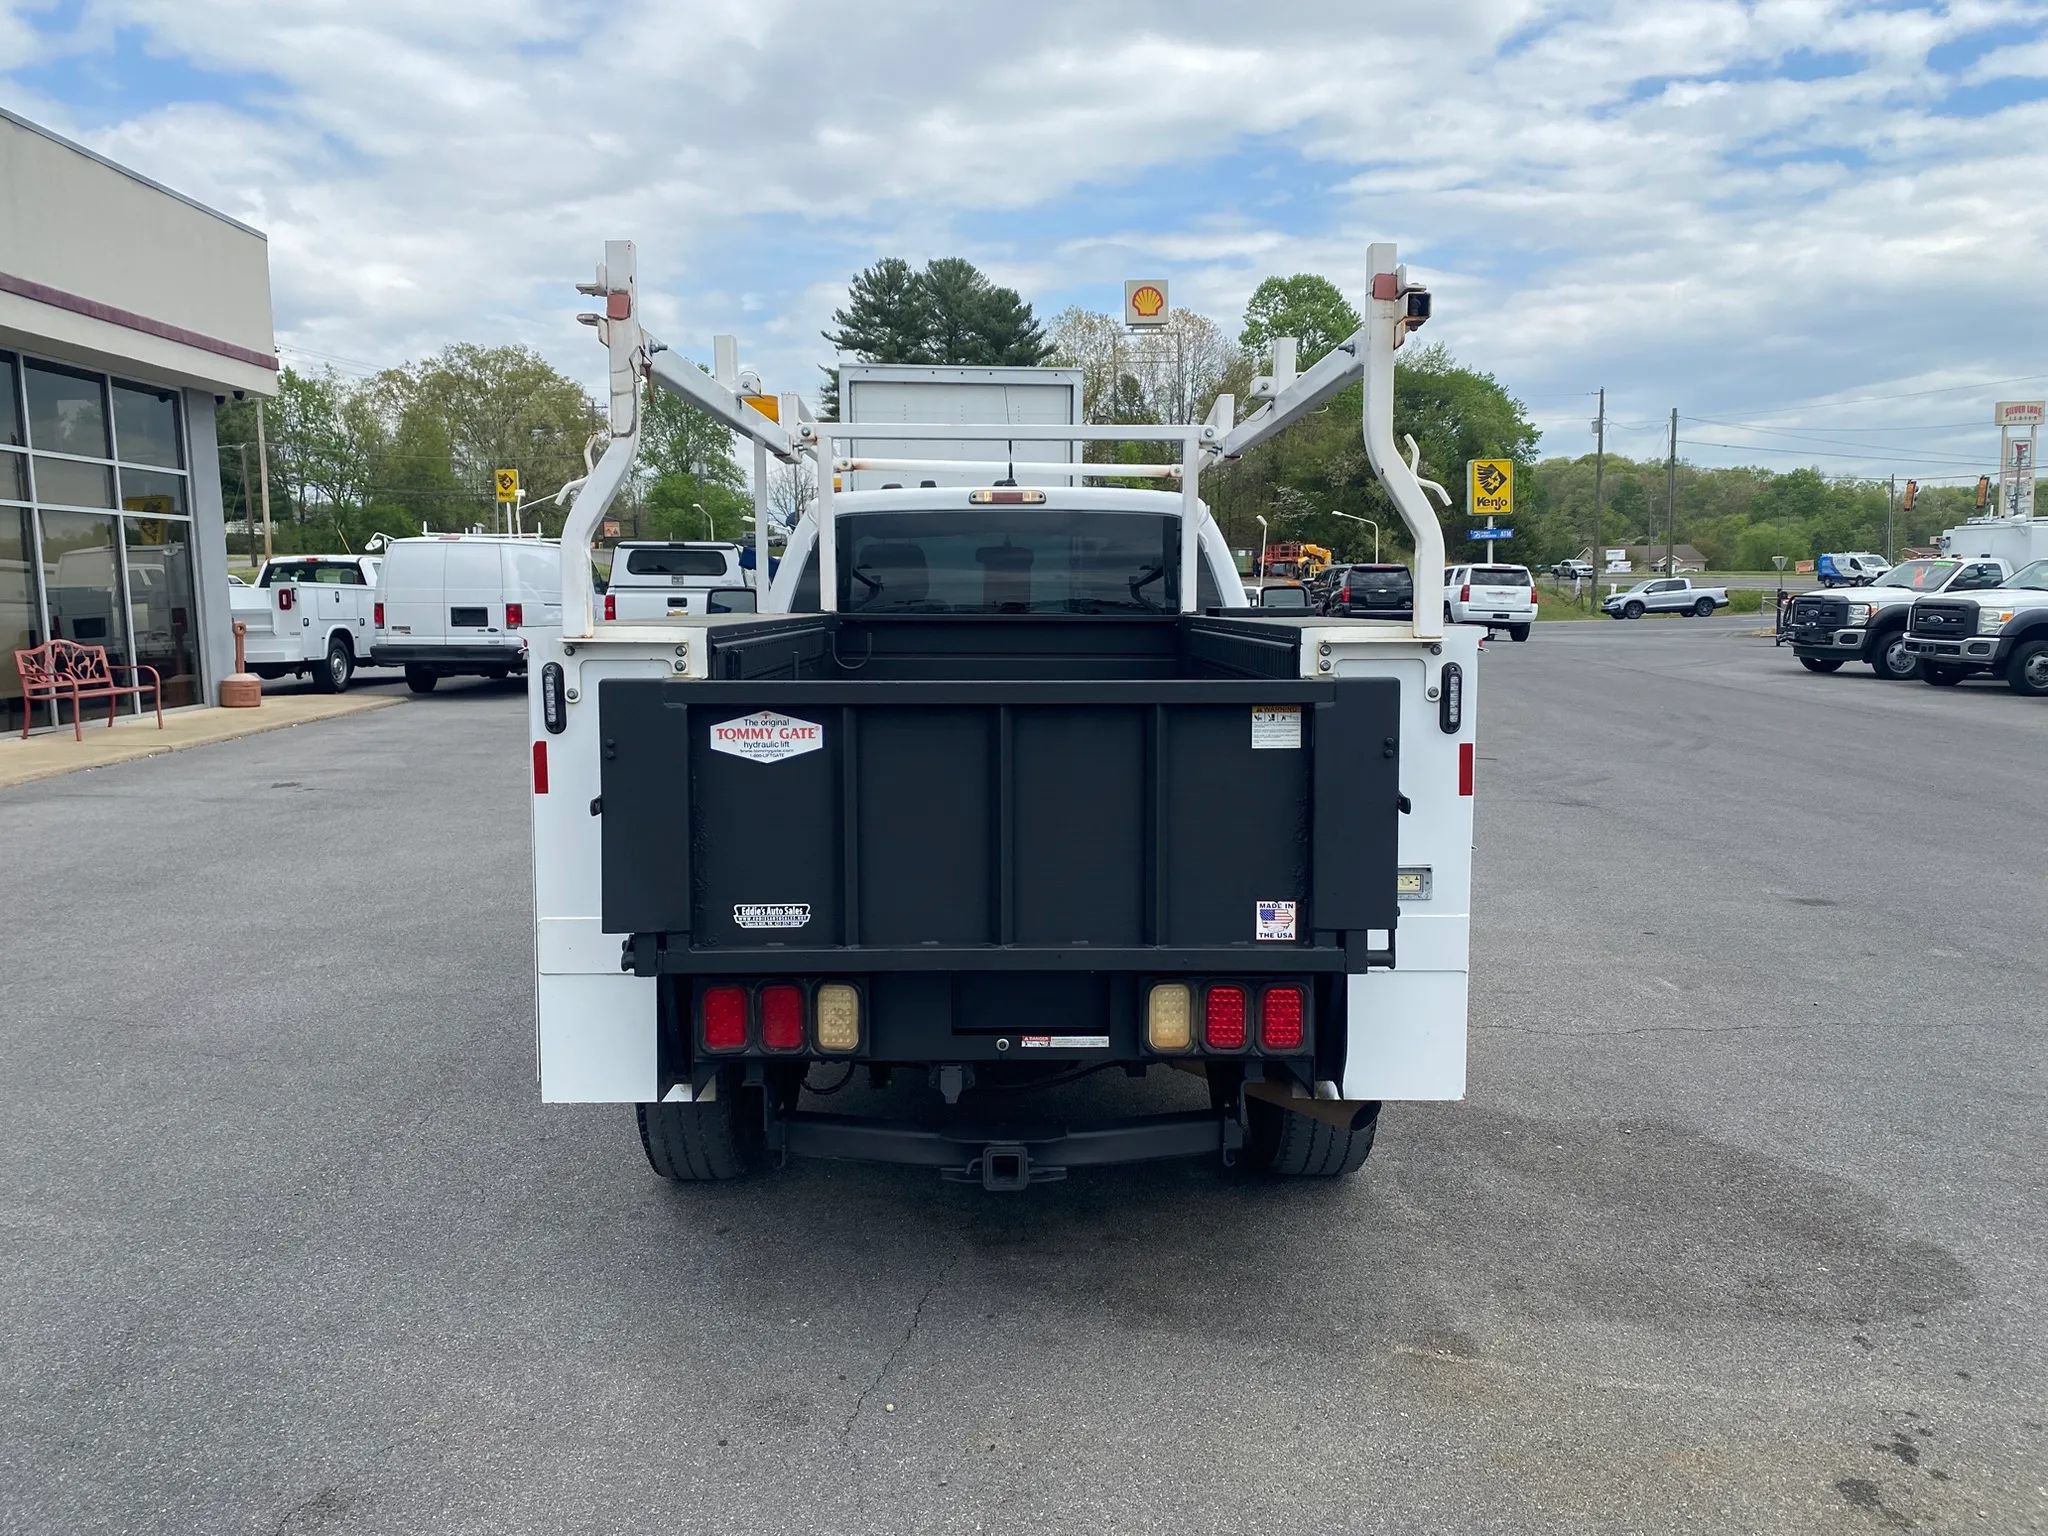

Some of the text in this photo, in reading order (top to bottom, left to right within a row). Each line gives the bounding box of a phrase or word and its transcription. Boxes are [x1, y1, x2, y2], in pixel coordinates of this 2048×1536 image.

[1476, 496, 1508, 511] Kenjo
[743, 718, 790, 728] The original
[716, 727, 816, 740] TOMMY GATE
[743, 740, 790, 750] hydraulic lift
[741, 906, 803, 915] Eddie's Auto Sales
